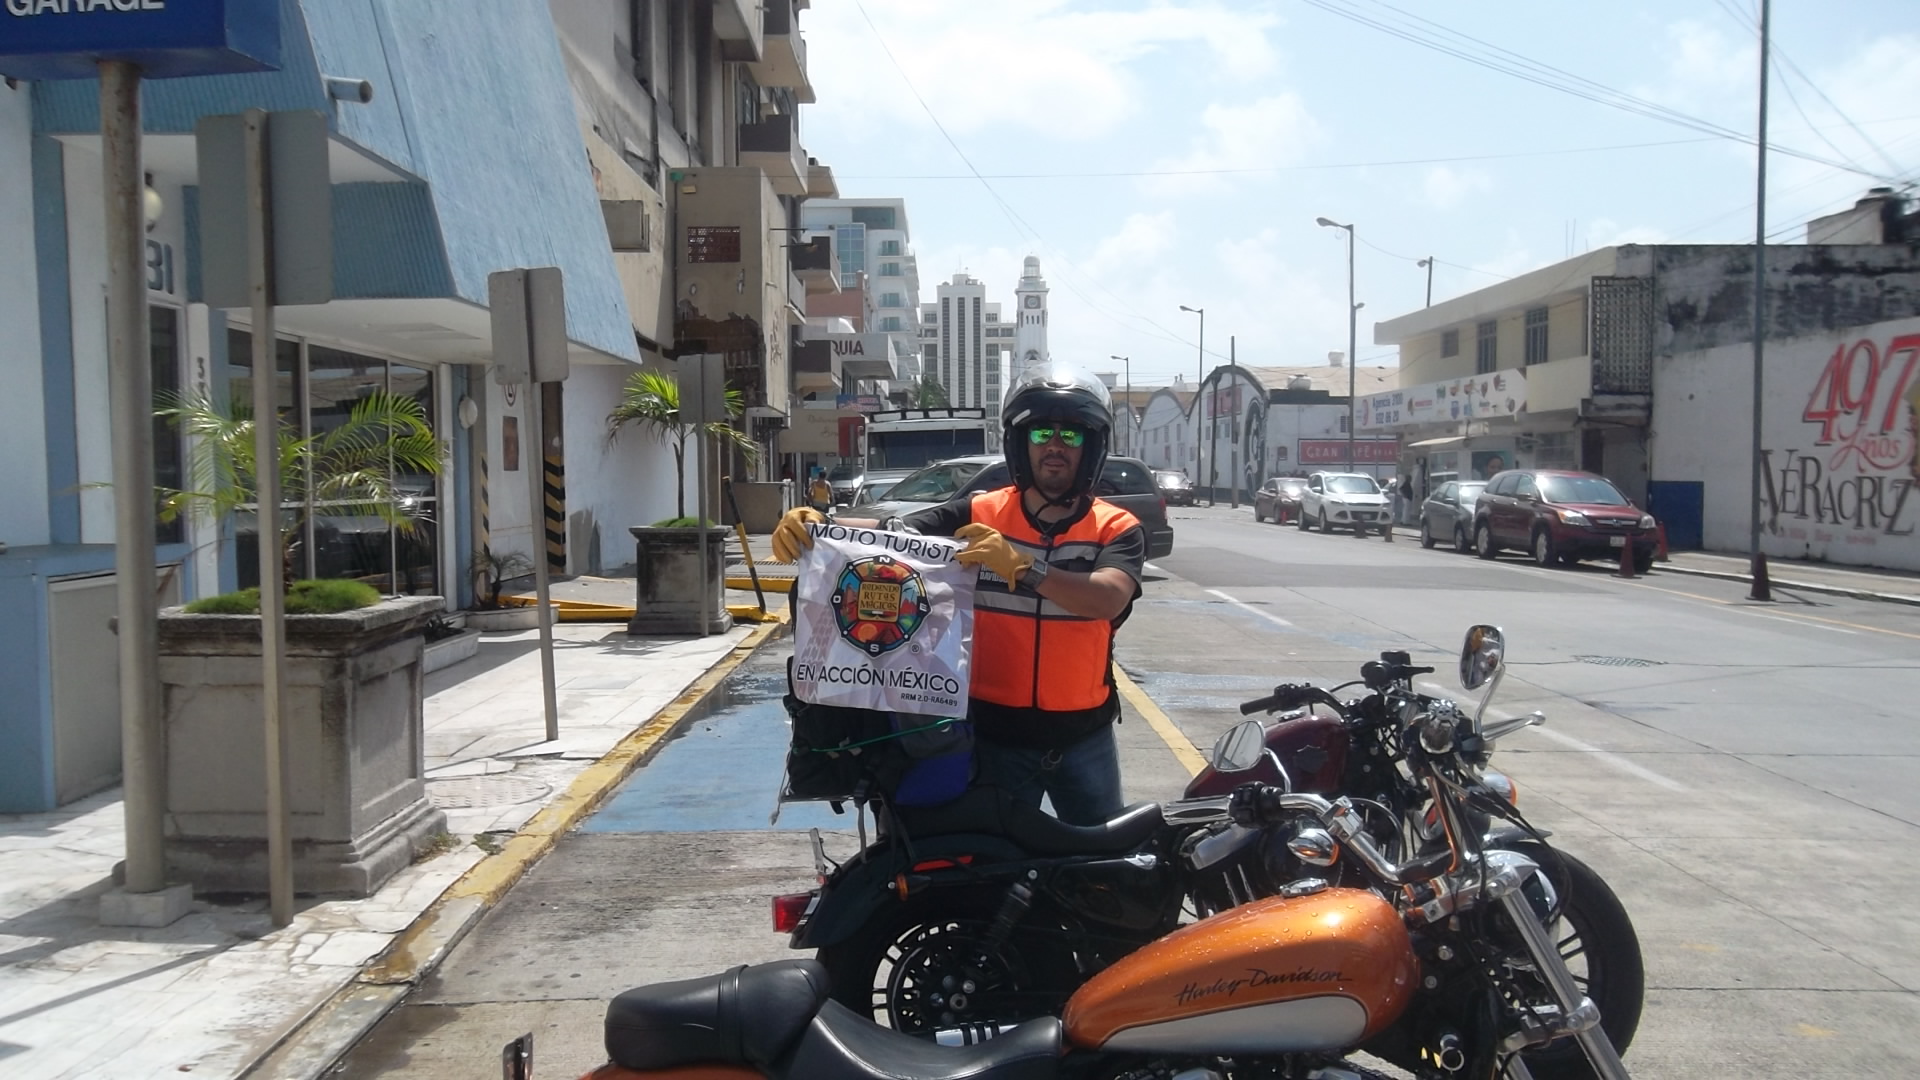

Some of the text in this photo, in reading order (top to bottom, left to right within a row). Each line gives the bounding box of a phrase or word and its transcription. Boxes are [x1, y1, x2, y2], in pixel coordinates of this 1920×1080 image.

[1802, 333, 1920, 447] 497
[1306, 446, 1338, 458] GRAN
[1760, 449, 1915, 536] VERACRUZ
[810, 524, 876, 546] MOTO
[796, 663, 960, 695] EN ACCIÓN MÉXICO
[900, 692, 917, 701] RRM
